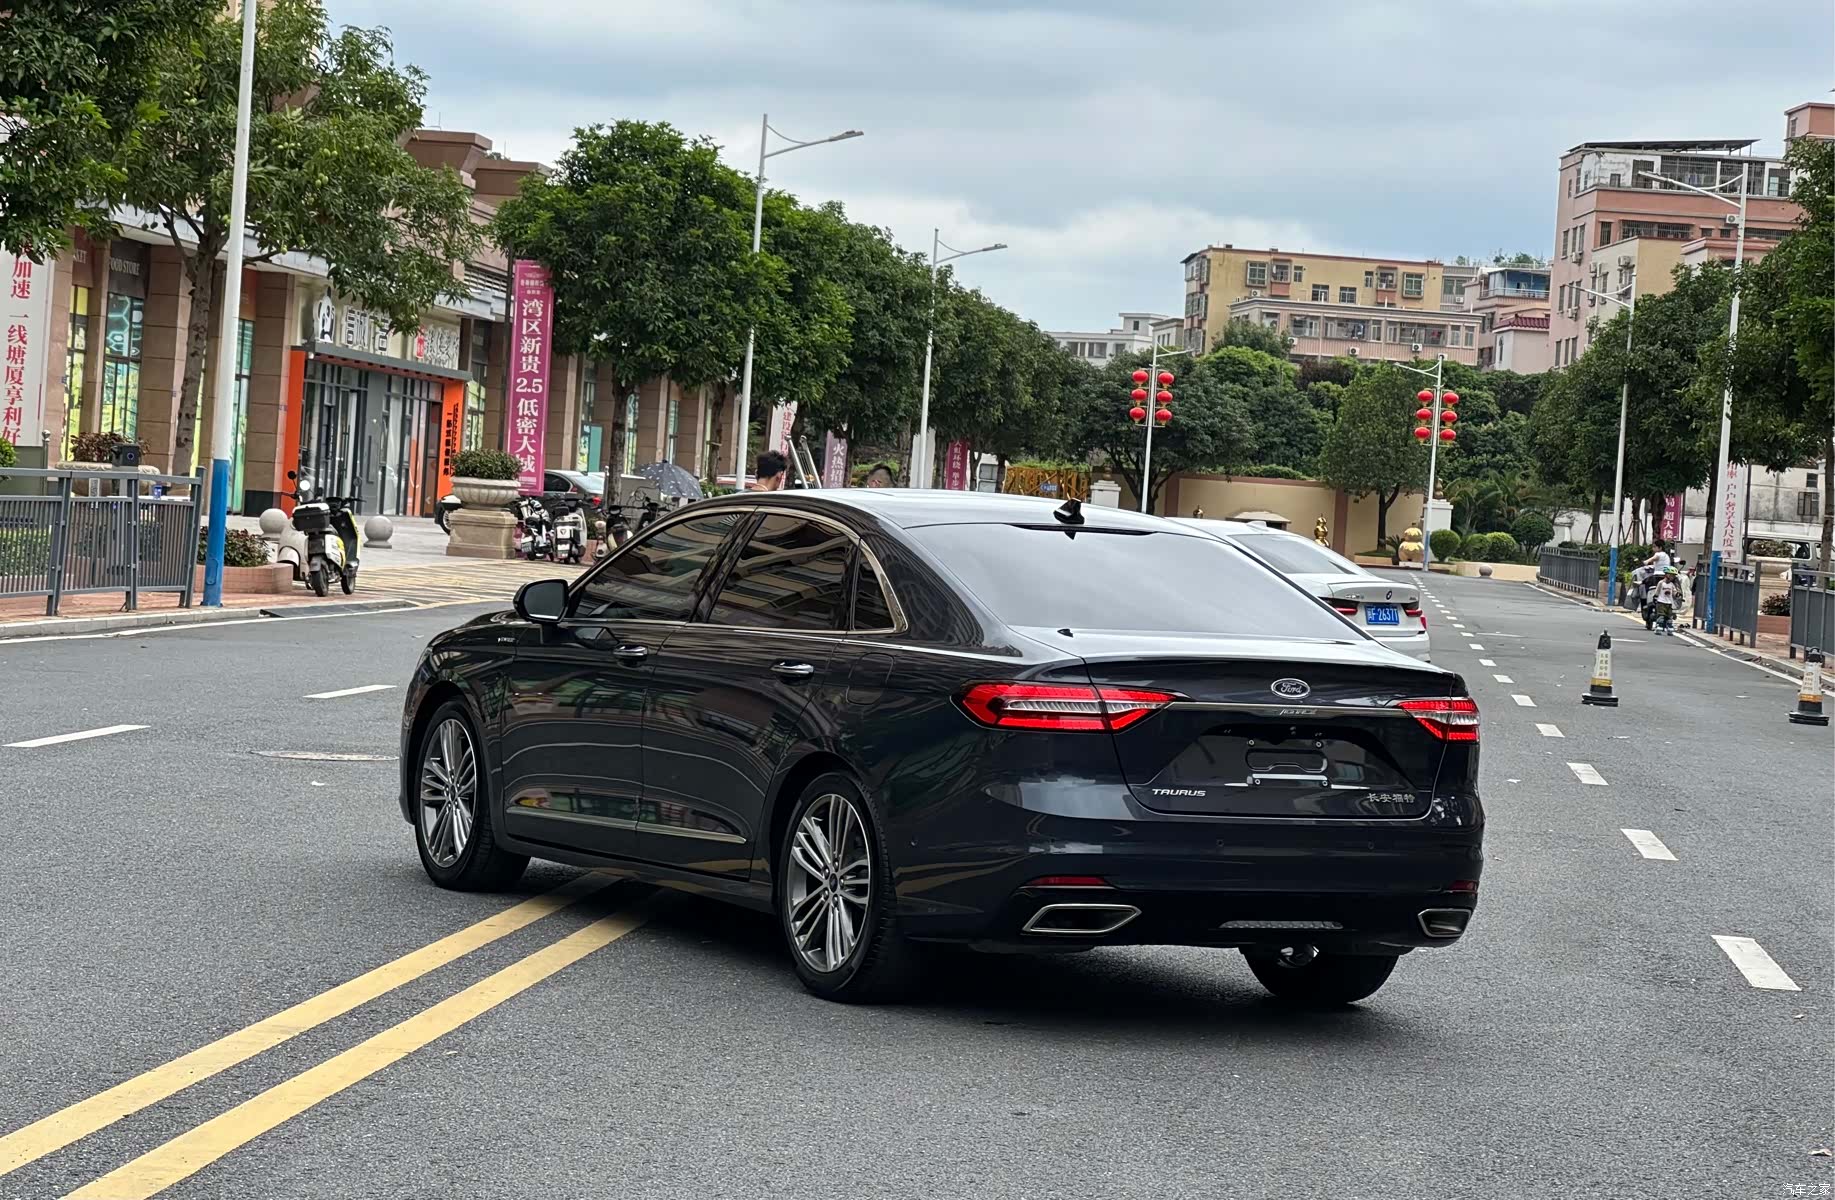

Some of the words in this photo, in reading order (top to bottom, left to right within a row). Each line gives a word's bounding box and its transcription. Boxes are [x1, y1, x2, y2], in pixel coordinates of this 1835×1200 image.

[109, 258, 122, 272] OOD
[123, 261, 140, 275] STORE
[1151, 788, 1206, 798] TAURUS
[1366, 792, 1416, 804] 长安福特
